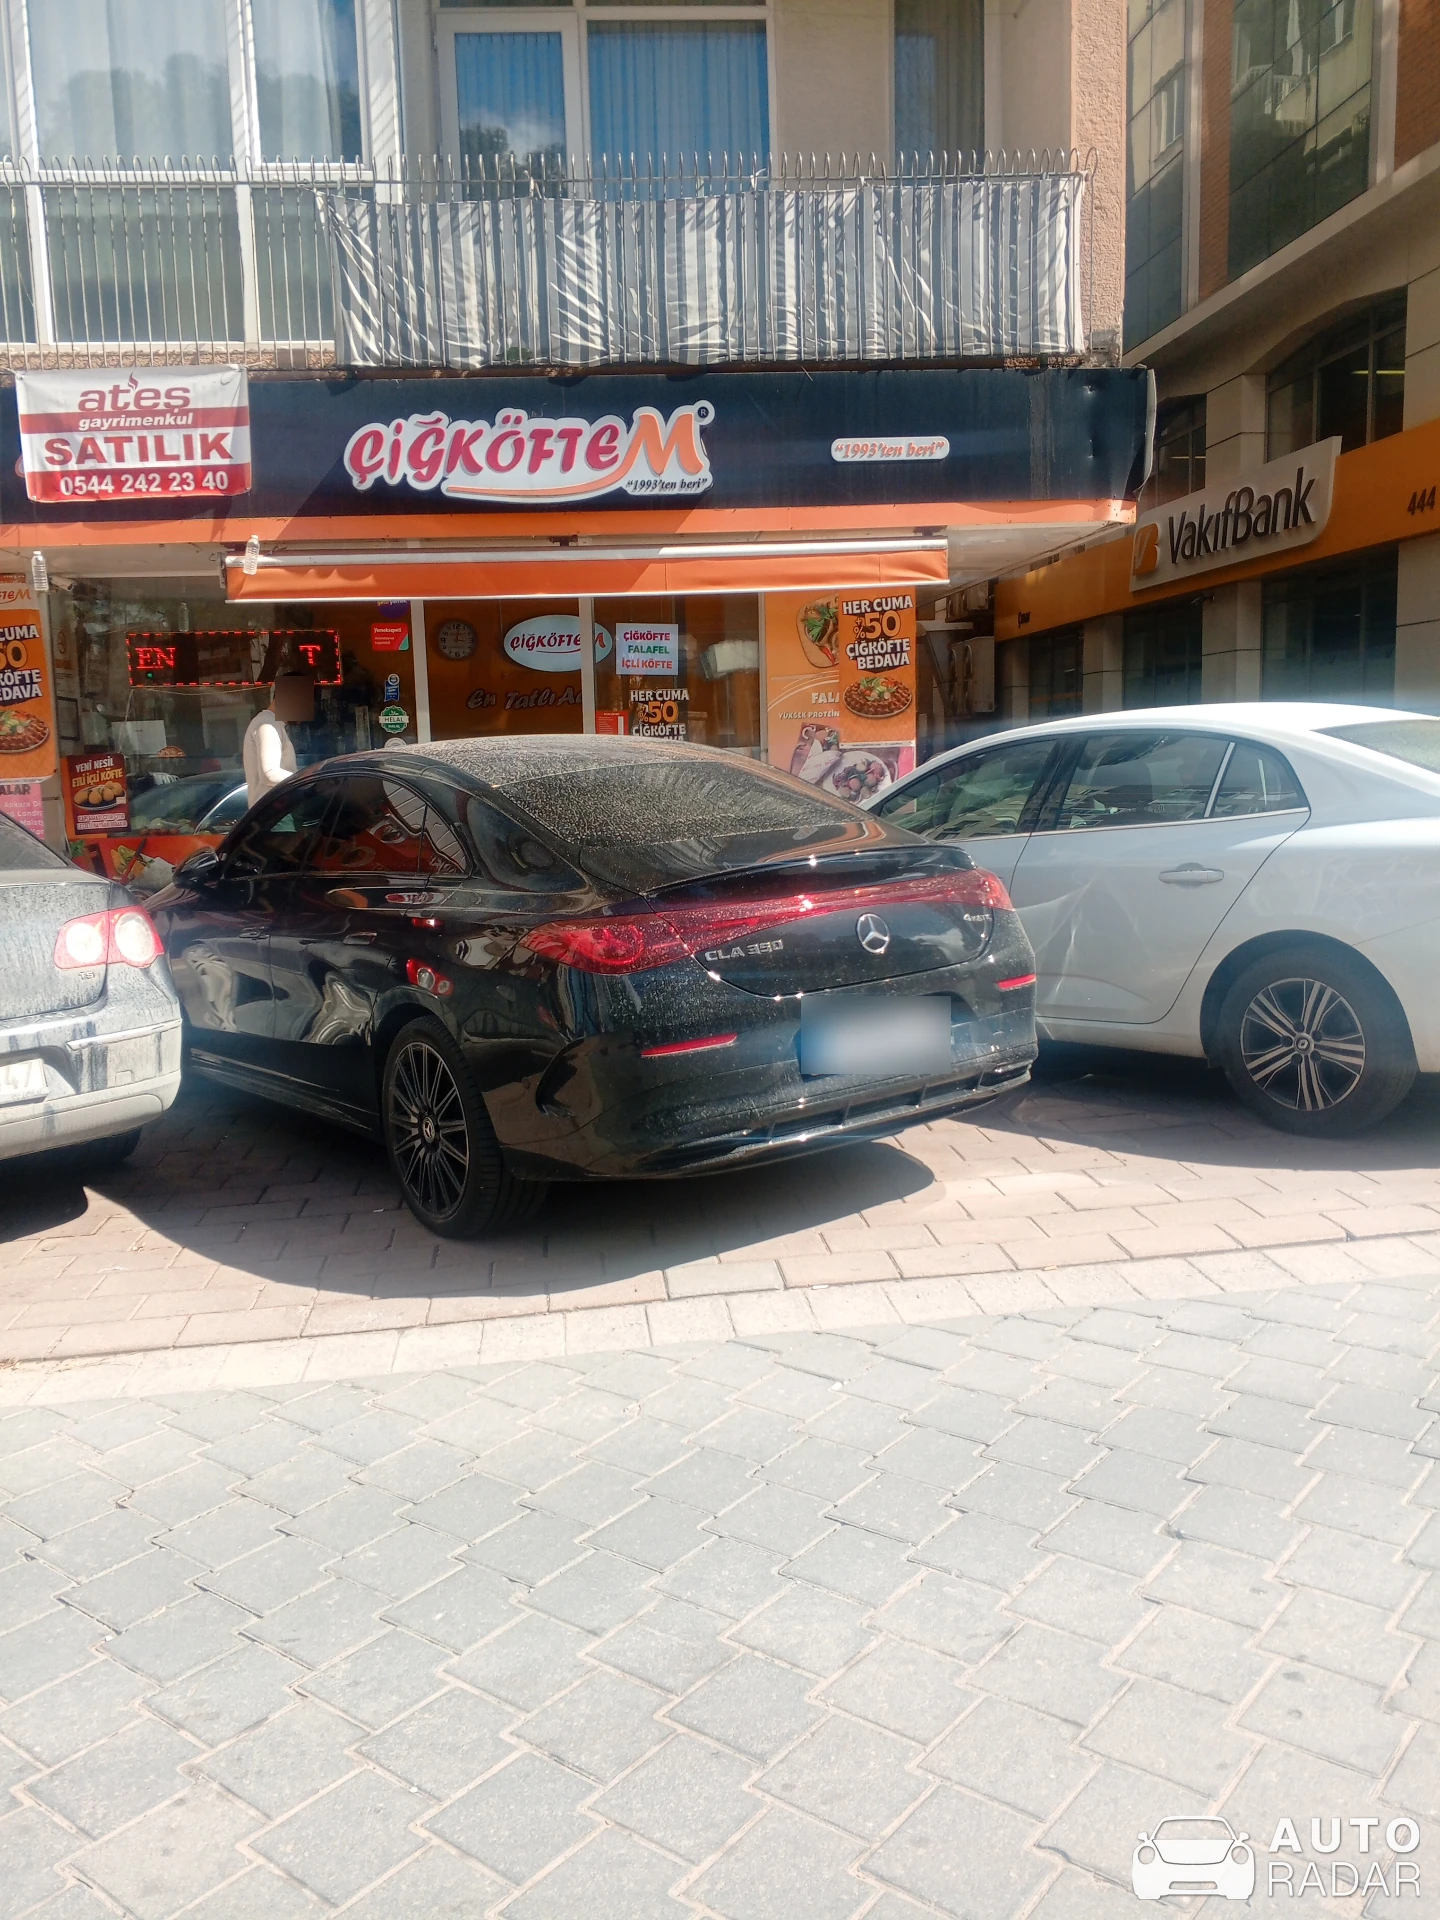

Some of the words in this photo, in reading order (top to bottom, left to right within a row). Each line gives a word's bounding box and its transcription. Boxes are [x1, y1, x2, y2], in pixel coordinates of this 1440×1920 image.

[78, 383, 191, 413] ateş
[78, 412, 194, 431] gayrimenkul
[44, 432, 233, 466] SATILIK
[60, 475, 114, 496] 0544
[120, 473, 162, 493] 242
[168, 471, 195, 492] 23
[201, 471, 229, 490] 40
[1407, 485, 1437, 516] 444
[1168, 466, 1316, 566] VakıfBank
[0, 589, 31, 600] TEM
[842, 600, 871, 615] HER
[873, 595, 914, 612] CUMA
[623, 630, 671, 642] ÇİĞKÖFTE
[628, 645, 670, 654] FALAFEL
[846, 638, 911, 660] ÇİĞKÖFTE
[621, 658, 640, 669] İÇLİ
[641, 658, 673, 669] KÖFTE
[857, 652, 910, 670] BEDAVA
[0, 683, 43, 701] DAVA
[467, 689, 497, 709] En
[631, 690, 654, 701] HER
[656, 689, 690, 701] CUMA
[76, 759, 92, 773] YENİ
[100, 768, 123, 781] KÖFTE
[705, 946, 745, 961] CLA
[747, 939, 784, 956] 350
